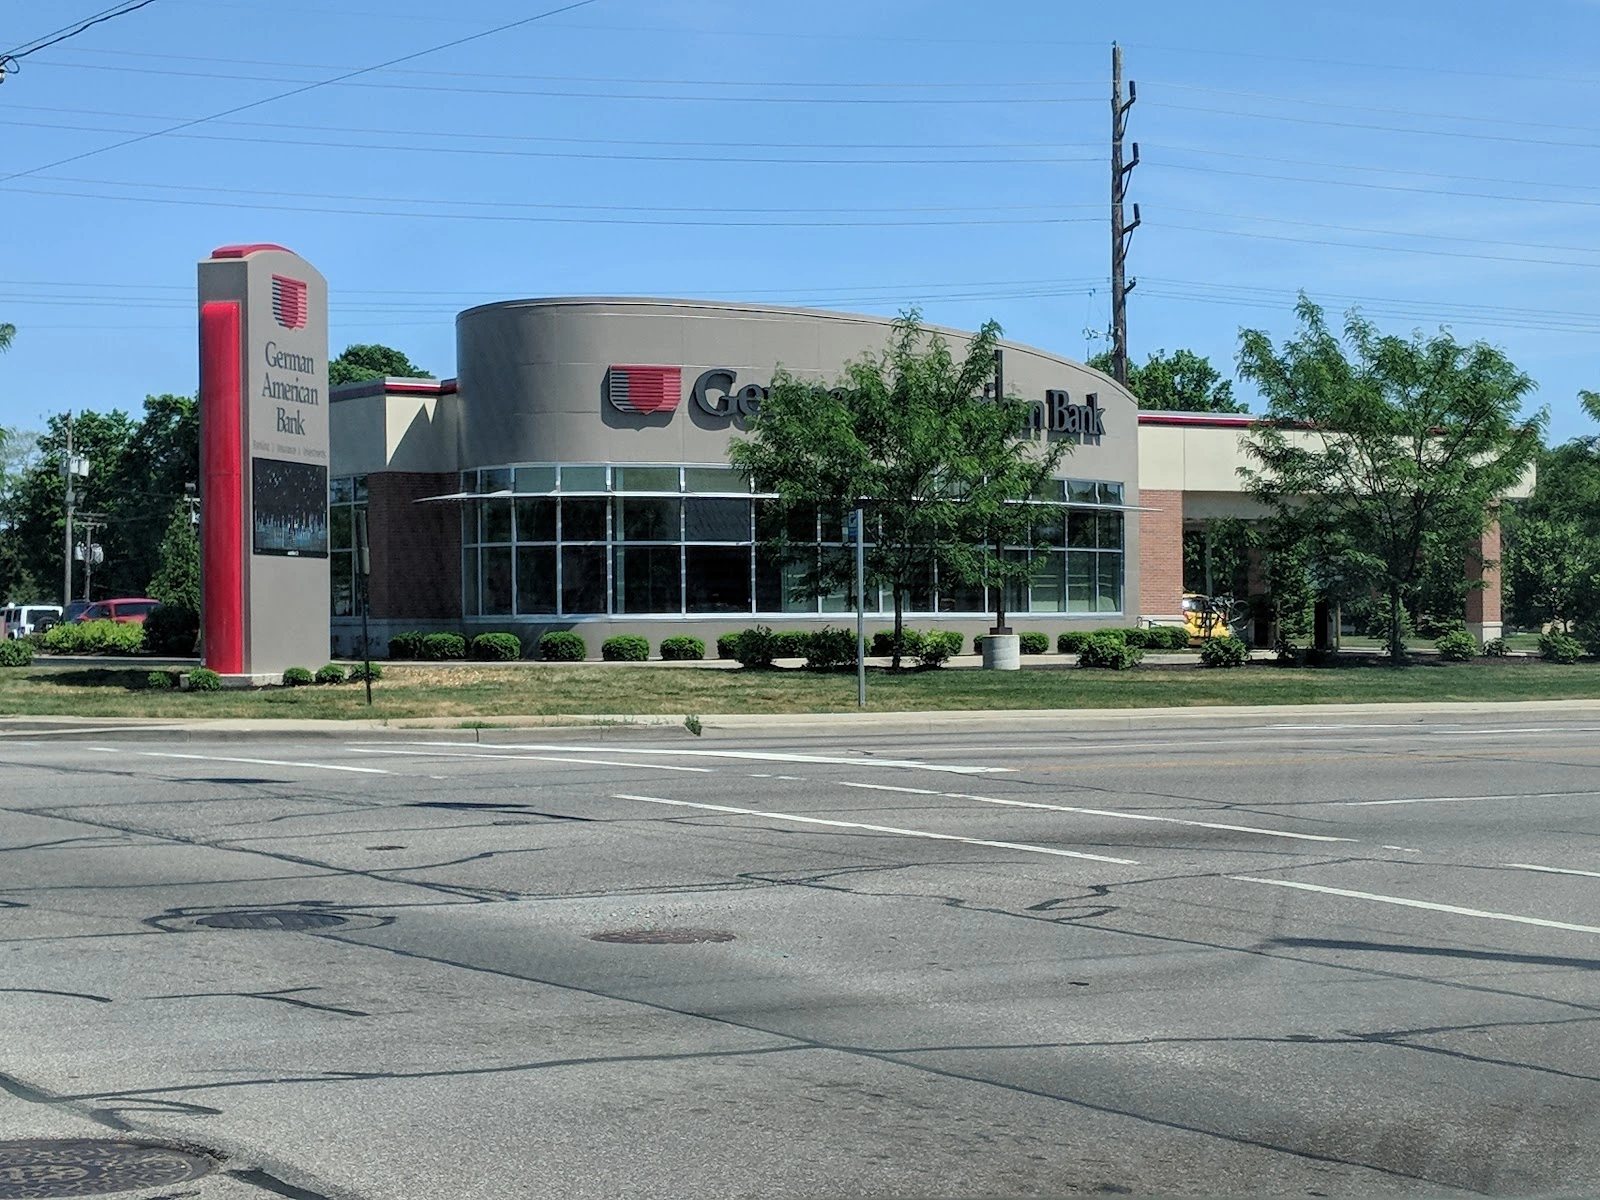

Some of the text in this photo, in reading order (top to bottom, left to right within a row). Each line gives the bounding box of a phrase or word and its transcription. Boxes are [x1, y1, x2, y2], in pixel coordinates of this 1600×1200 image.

[265, 341, 315, 375] German
[261, 372, 319, 406] American
[276, 407, 306, 436] Bank
[1045, 389, 1106, 435] Bank
